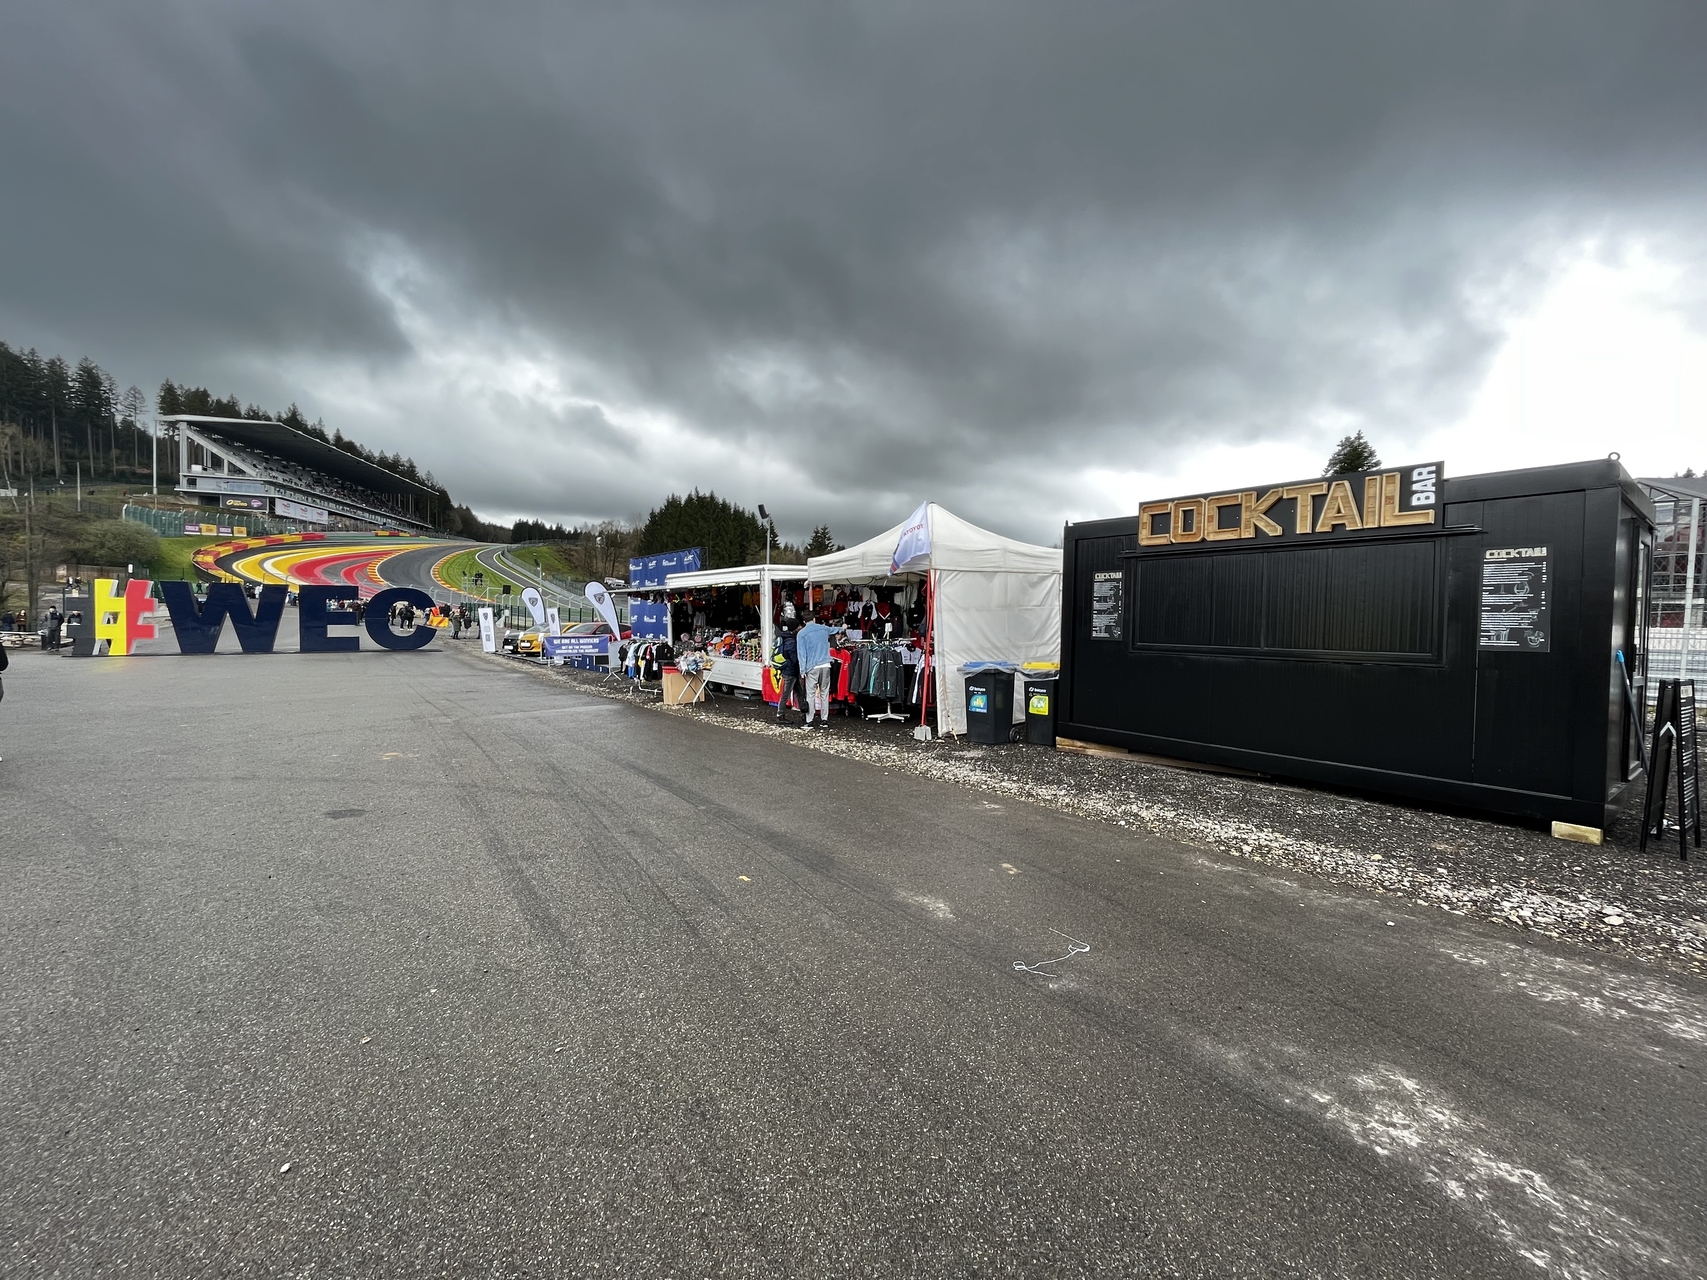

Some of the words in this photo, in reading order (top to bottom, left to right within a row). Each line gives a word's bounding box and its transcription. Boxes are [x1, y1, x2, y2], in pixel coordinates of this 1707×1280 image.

[1411, 465, 1436, 506] BAR
[1138, 472, 1435, 546] COCKTAIL
[1485, 547, 1547, 559] COCKTAIL
